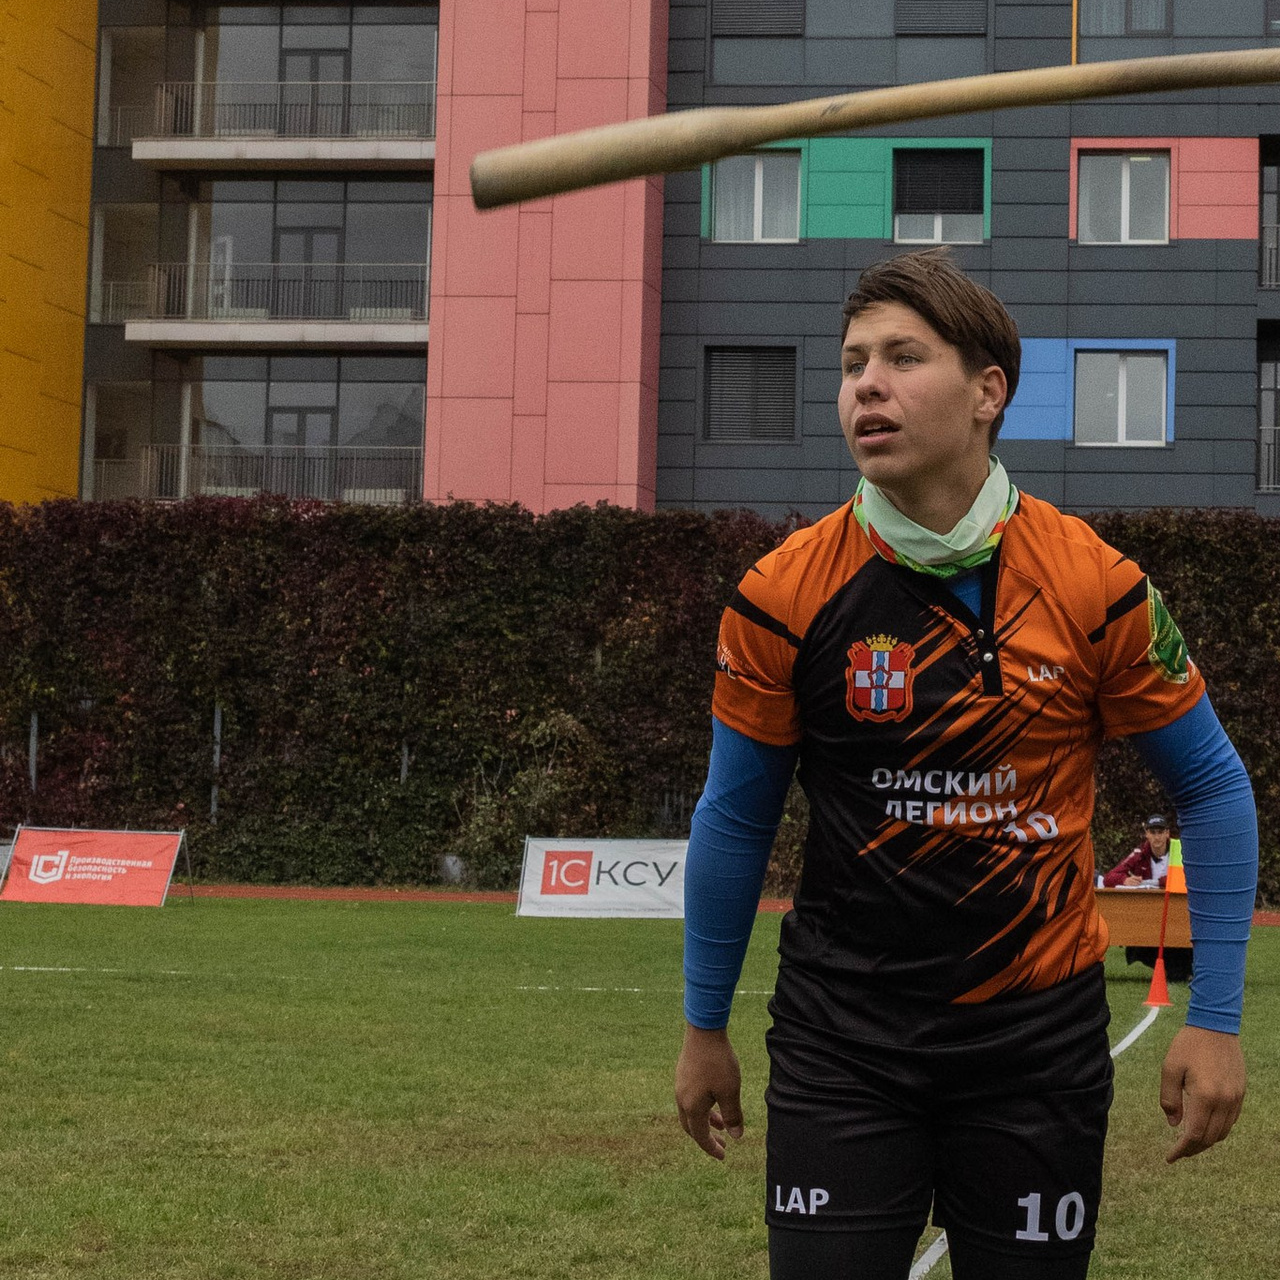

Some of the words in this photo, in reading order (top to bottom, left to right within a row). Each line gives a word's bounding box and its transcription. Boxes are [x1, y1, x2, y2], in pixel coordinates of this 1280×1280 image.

[1027, 664, 1065, 682] LAP
[871, 764, 1017, 797] ОМСКИЙ
[885, 800, 1018, 826] ЛЕГИОН
[67, 864, 128, 875] безопасность
[70, 856, 153, 868] Производственная
[71, 872, 113, 881] экология
[775, 1185, 830, 1215] LAP
[1016, 1191, 1086, 1242] 10
